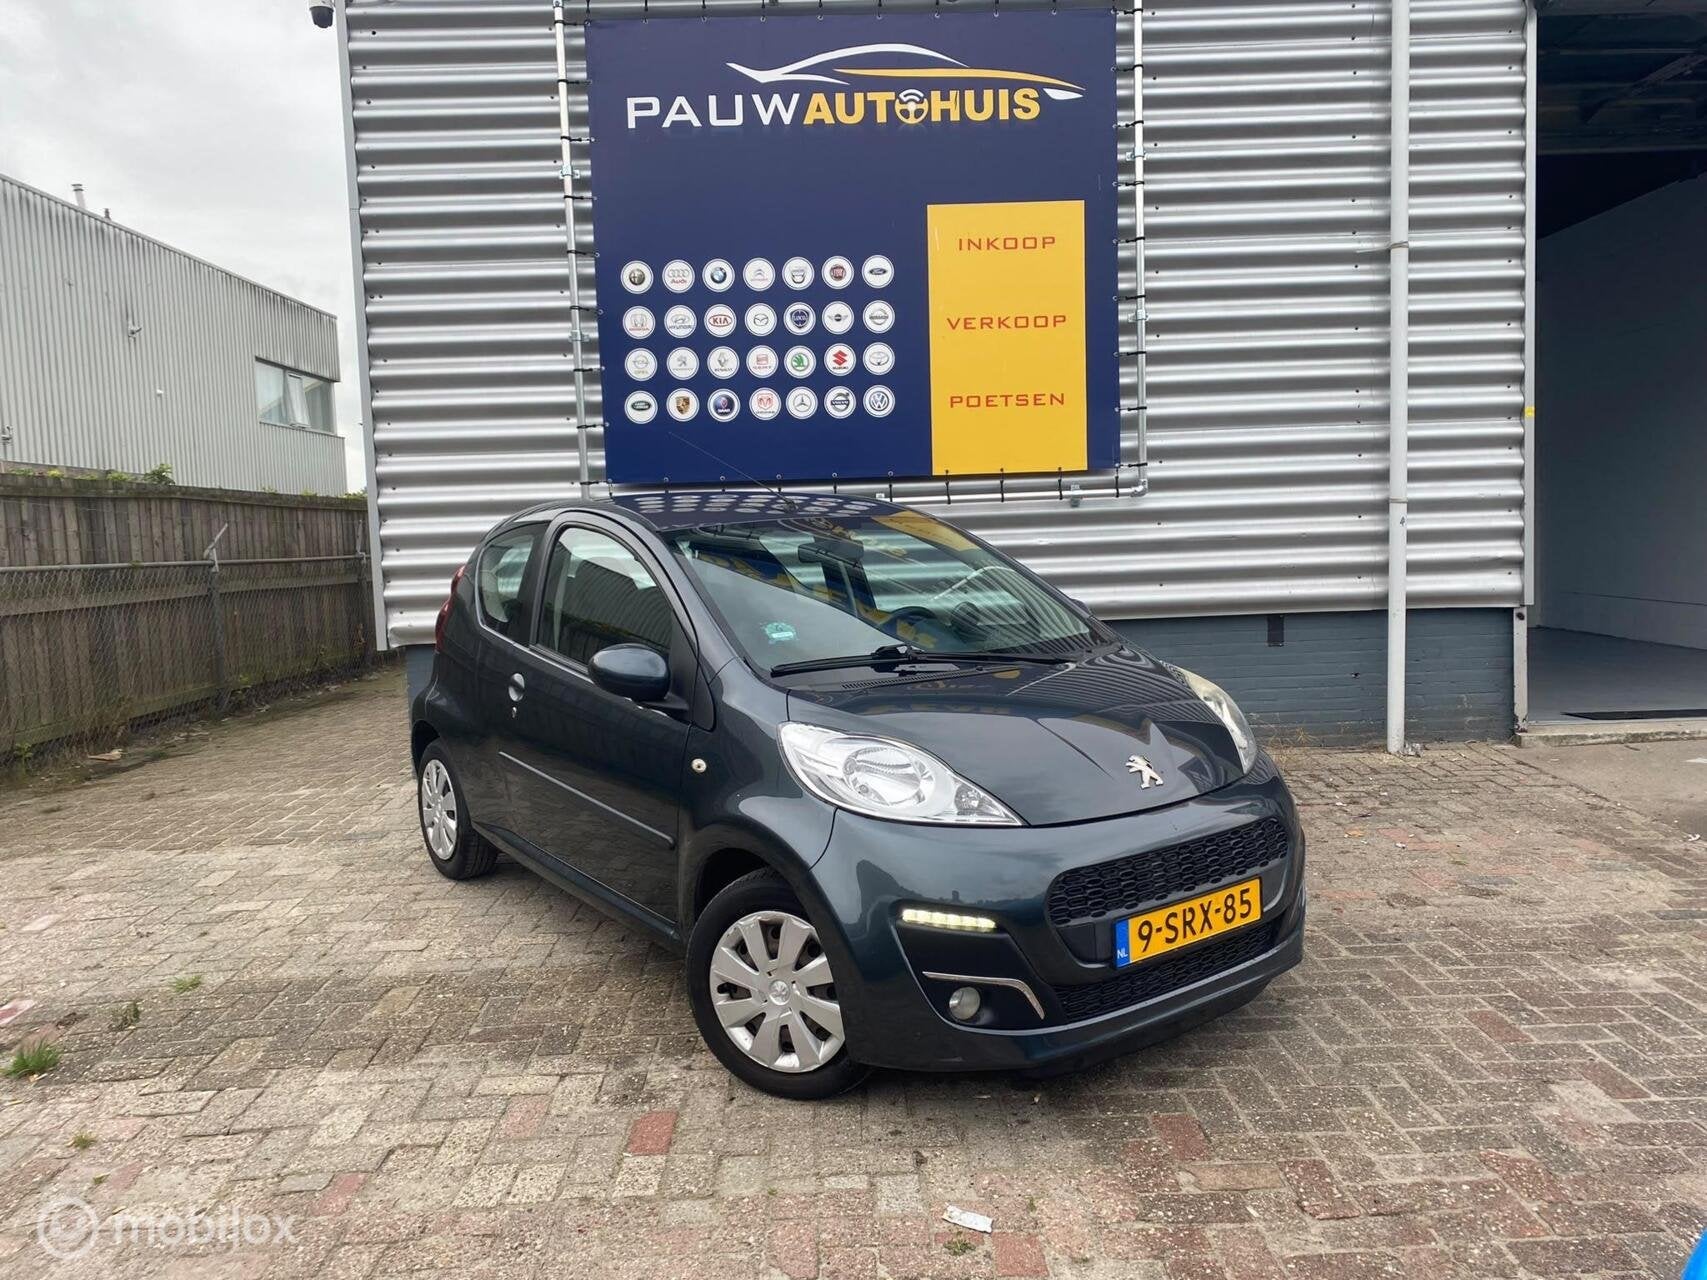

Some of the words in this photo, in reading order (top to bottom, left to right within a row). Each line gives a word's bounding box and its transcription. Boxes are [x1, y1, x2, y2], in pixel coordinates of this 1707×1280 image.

[958, 236, 1056, 251] INKOOP
[712, 317, 729, 325] KIA
[947, 315, 1067, 330] VERKOOP
[950, 393, 1065, 408] POETSEN
[1137, 887, 1252, 953] 9-SRX-85
[1117, 948, 1128, 959] NL
